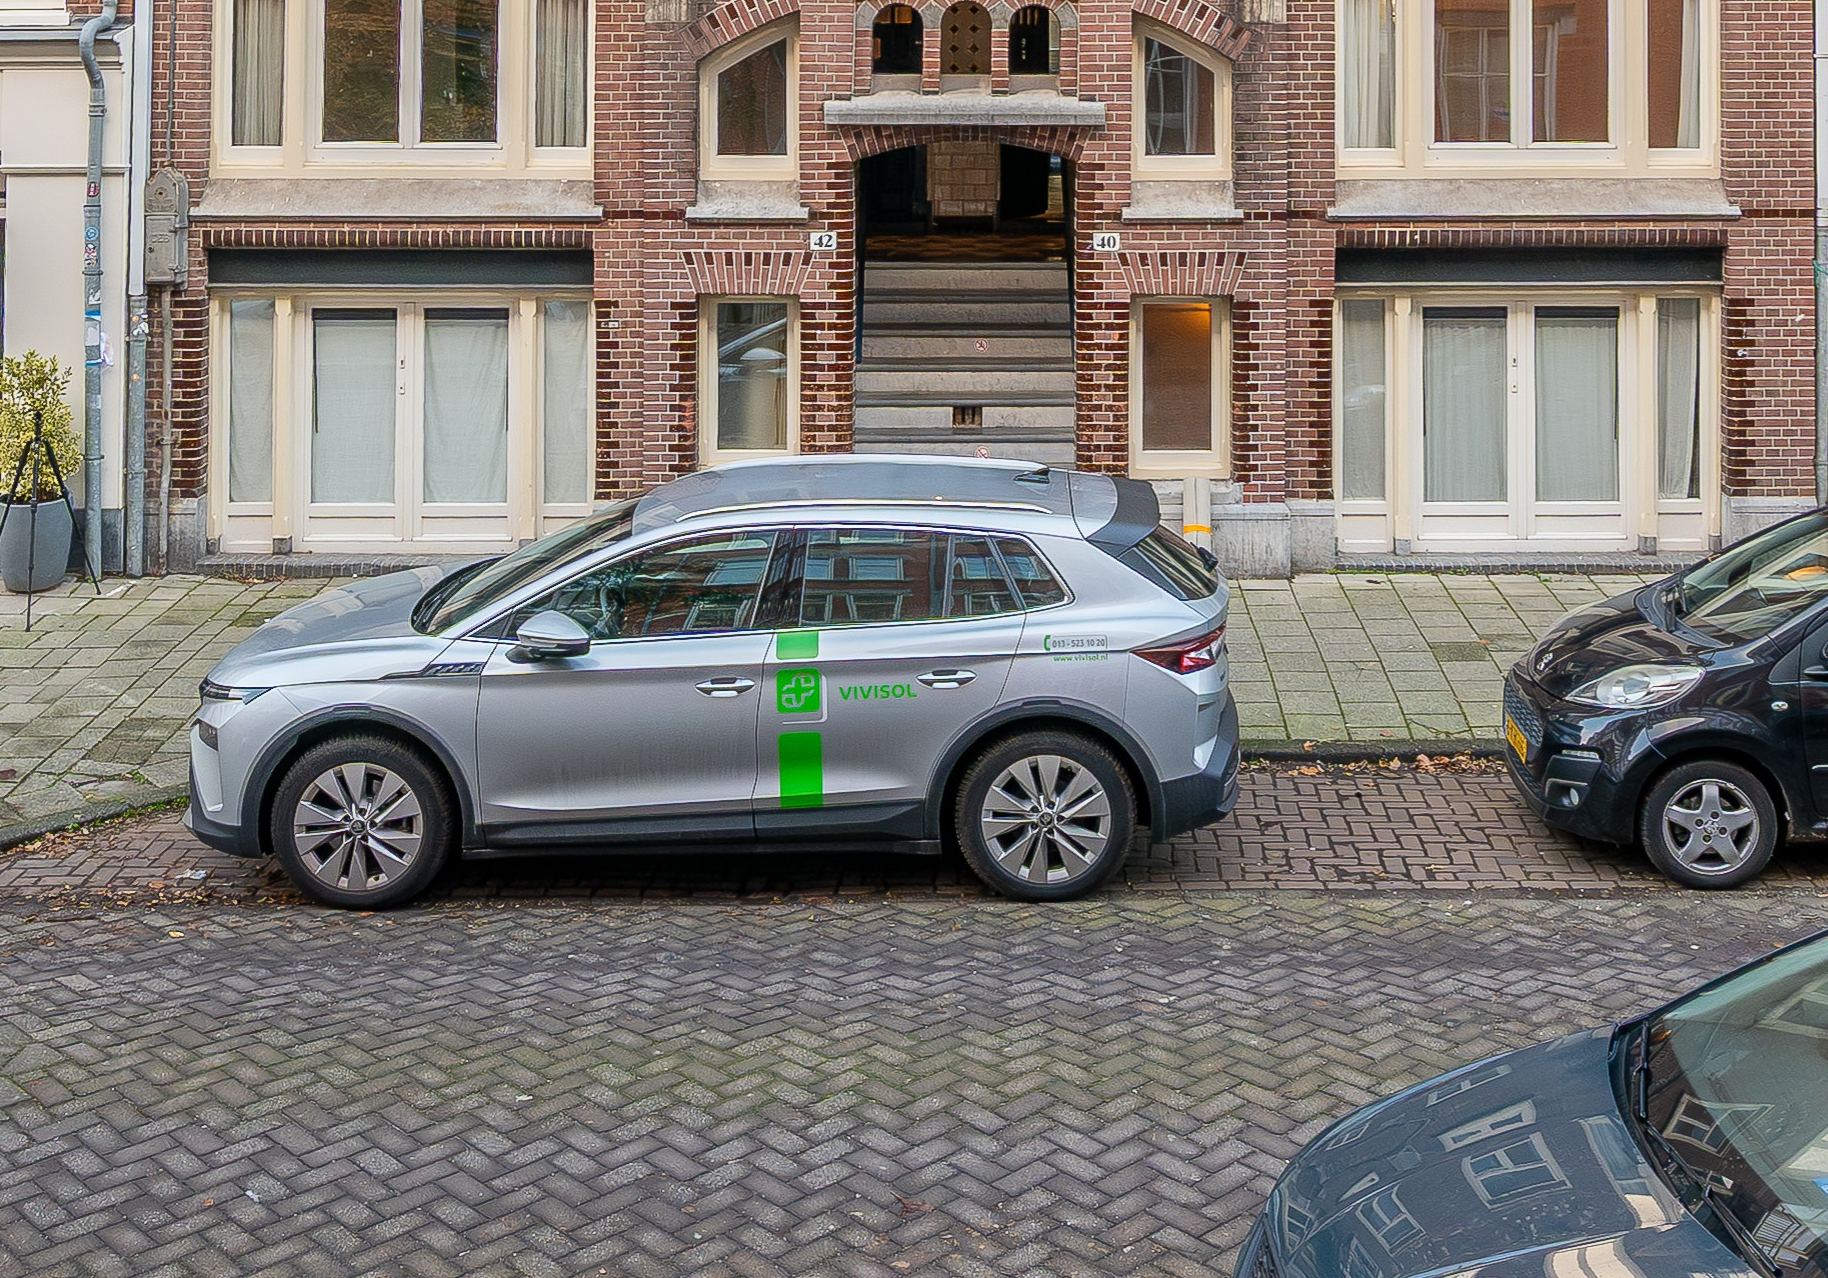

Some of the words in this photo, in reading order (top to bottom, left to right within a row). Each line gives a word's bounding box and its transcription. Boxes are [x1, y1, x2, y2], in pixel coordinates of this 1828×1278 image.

[814, 234, 833, 247] 42
[1097, 235, 1117, 248] 40
[838, 683, 918, 701] VIVISOL
